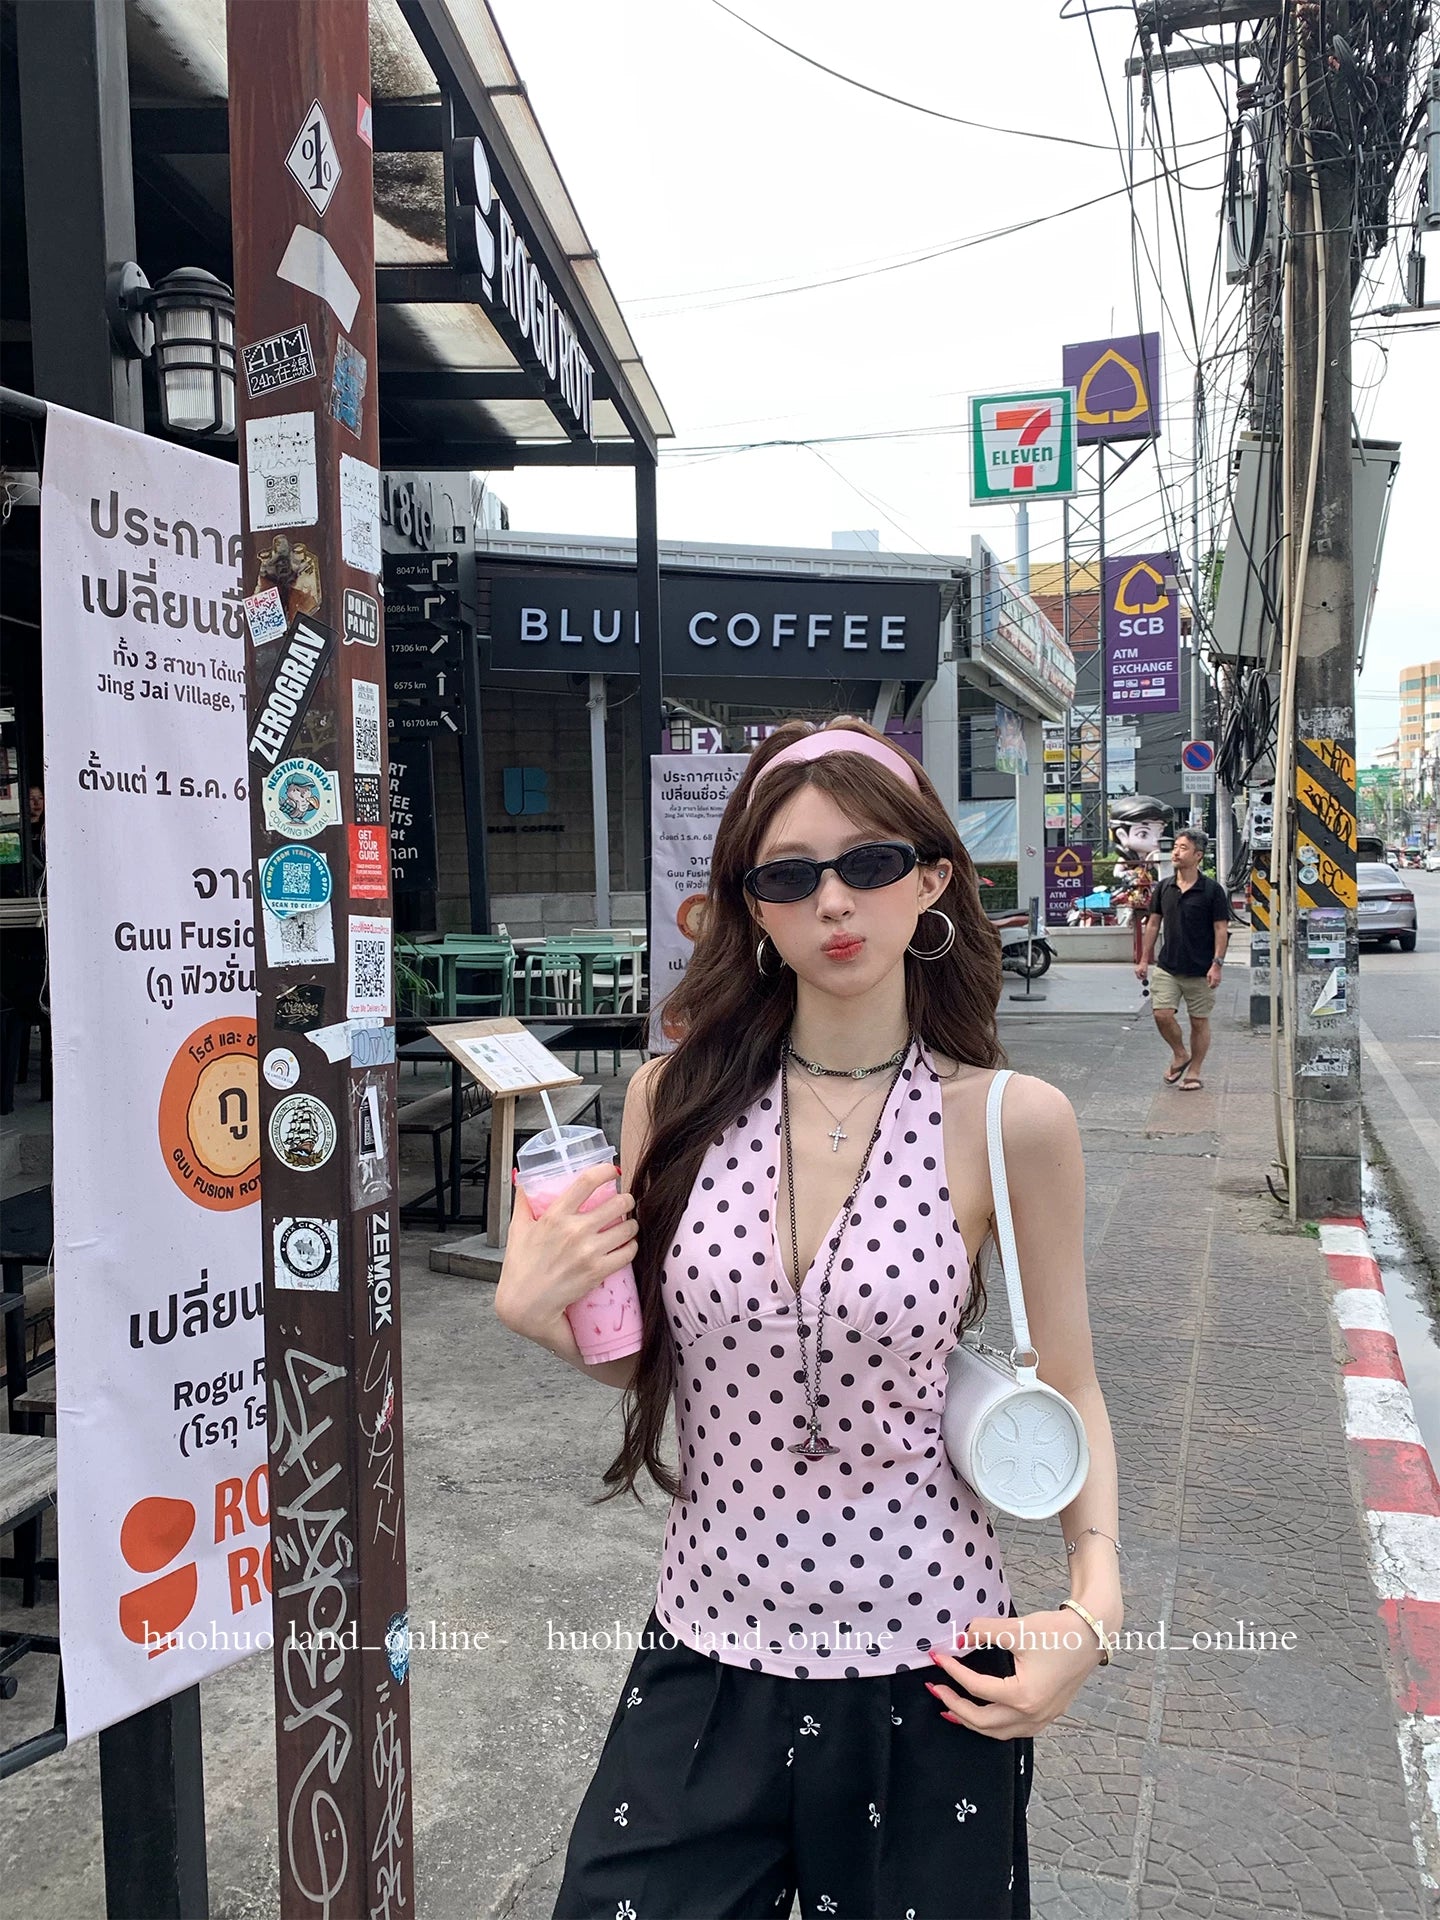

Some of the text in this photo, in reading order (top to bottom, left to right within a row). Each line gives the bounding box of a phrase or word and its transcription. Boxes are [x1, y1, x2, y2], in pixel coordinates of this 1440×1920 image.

[499, 198, 595, 443] ROGU ROTI
[248, 331, 306, 371] ATM
[416, 566, 430, 575] km
[347, 594, 377, 618] DON'T
[347, 614, 375, 639] PANIC
[520, 608, 907, 651] BLU COFFEE
[1119, 617, 1165, 637] SCB
[113, 636, 139, 668] ทั้ง
[145, 651, 157, 670] 3
[163, 656, 206, 678] สาขา
[1113, 648, 1138, 659] ATM
[1112, 661, 1174, 675] EXCHANGE
[97, 673, 135, 701] Jing
[140, 680, 169, 700] Jai
[174, 684, 236, 713] Village,
[249, 622, 326, 764] ZEROGRAV
[78, 750, 148, 794] ตั้งแต่
[155, 771, 172, 796] 1
[179, 776, 227, 799] ธ.ค.
[268, 760, 332, 791] NESTING AWAY
[389, 794, 410, 810] EE
[269, 810, 330, 837] COLIVING IN ITALY
[357, 829, 373, 840] GET
[358, 840, 378, 851] YOUR
[358, 850, 380, 860] GUIDE
[266, 865, 275, 889] WORK
[273, 849, 290, 865] FROM
[292, 848, 312, 859] ITALY
[667, 870, 684, 878] Guu
[1049, 891, 1067, 899] ATM
[1056, 878, 1082, 888] SCB
[114, 921, 171, 951] Guu
[219, 1031, 242, 1048] และ
[218, 1087, 248, 1140] กู
[173, 1147, 194, 1179] GUU
[193, 1177, 235, 1200] FUSION
[298, 1222, 329, 1245] CIARS
[366, 1265, 374, 1288] 24K
[372, 1211, 393, 1331] ZEMOK
[173, 1369, 244, 1411] Rogu
